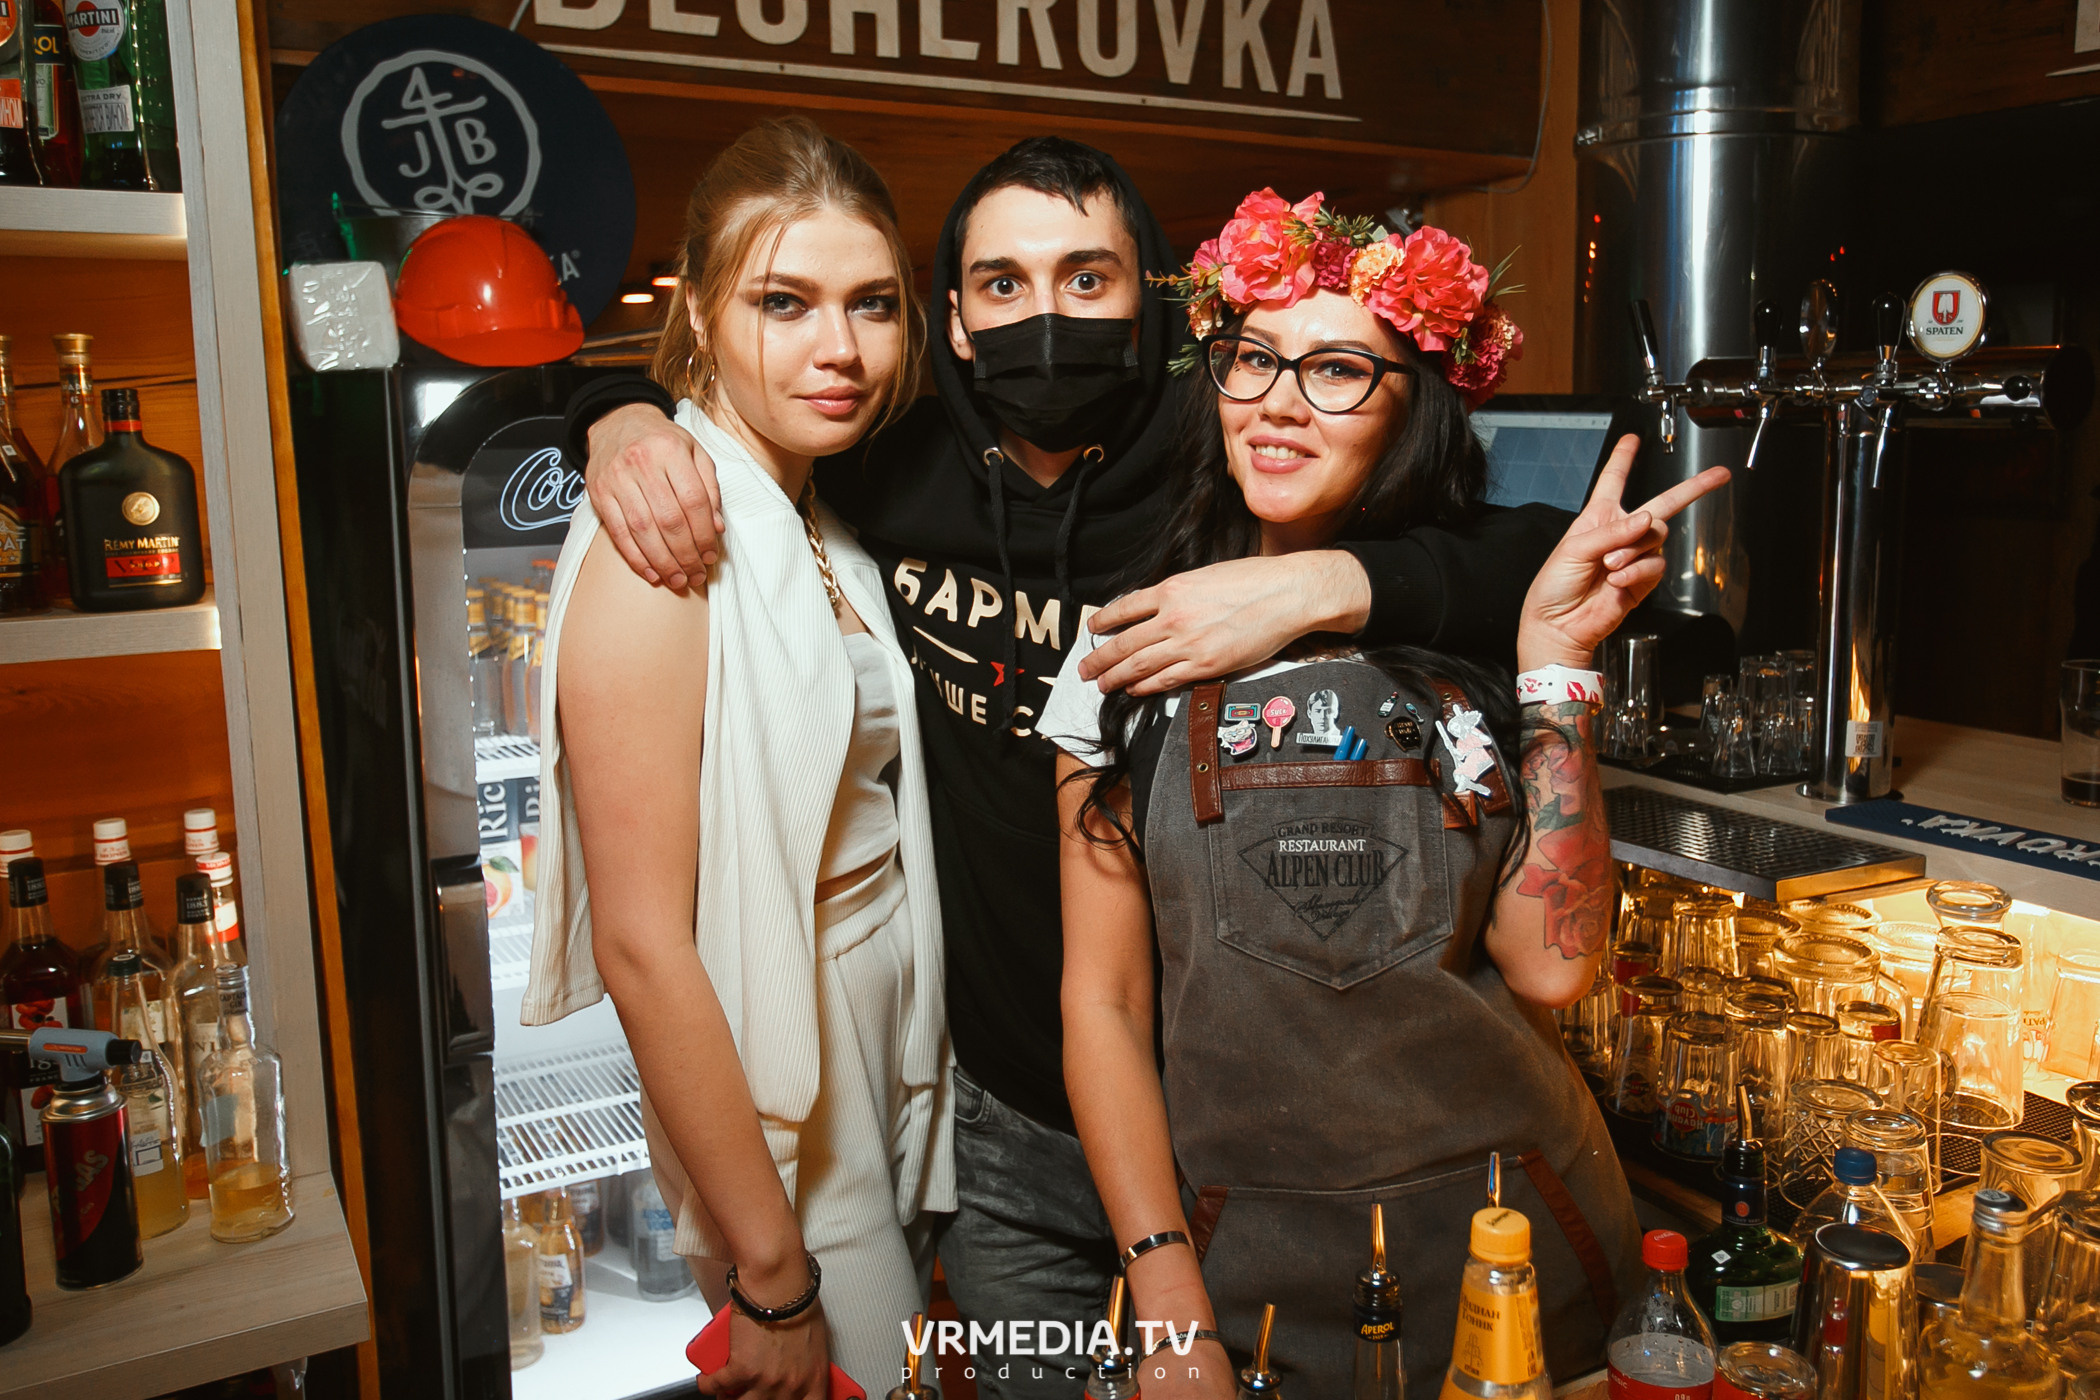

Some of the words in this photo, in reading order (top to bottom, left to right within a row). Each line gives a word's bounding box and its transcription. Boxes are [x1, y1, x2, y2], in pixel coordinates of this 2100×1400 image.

[67, 9, 117, 28] MARTINI
[103, 92, 121, 100] DRY
[1926, 326, 1964, 336] SPATEN
[137, 535, 180, 550] MARTIN
[1278, 822, 1318, 838] GRAND
[1321, 822, 1369, 836] RESORT
[1279, 839, 1367, 852] RESTAURANT
[1265, 850, 1330, 891] ALPEN
[1334, 850, 1385, 887] CLUB
[1674, 1104, 1696, 1118] Club
[1361, 1321, 1394, 1335] APEROL
